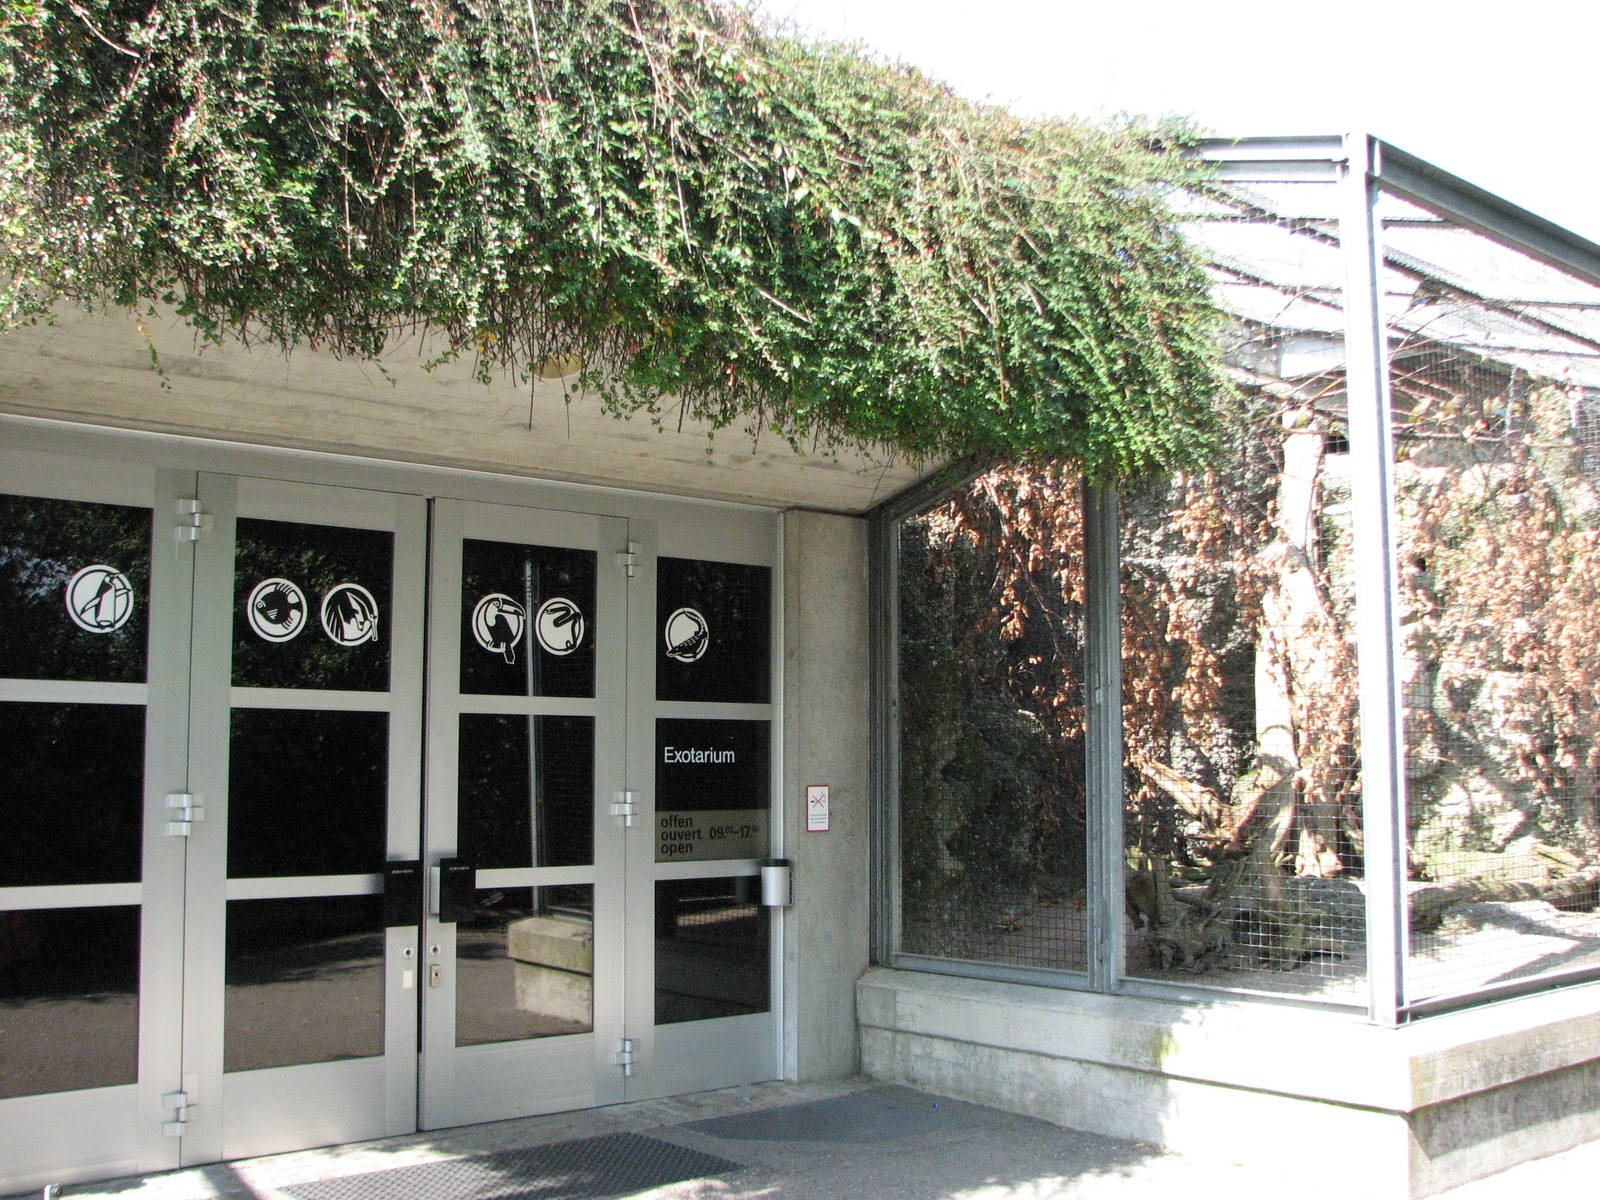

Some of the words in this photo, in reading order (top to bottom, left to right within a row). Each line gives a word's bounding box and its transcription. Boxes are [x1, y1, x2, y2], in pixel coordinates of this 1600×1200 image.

[664, 747, 735, 763] Exotarium
[661, 814, 693, 828] offen
[661, 828, 702, 841] ouvert
[661, 842, 693, 857] open
